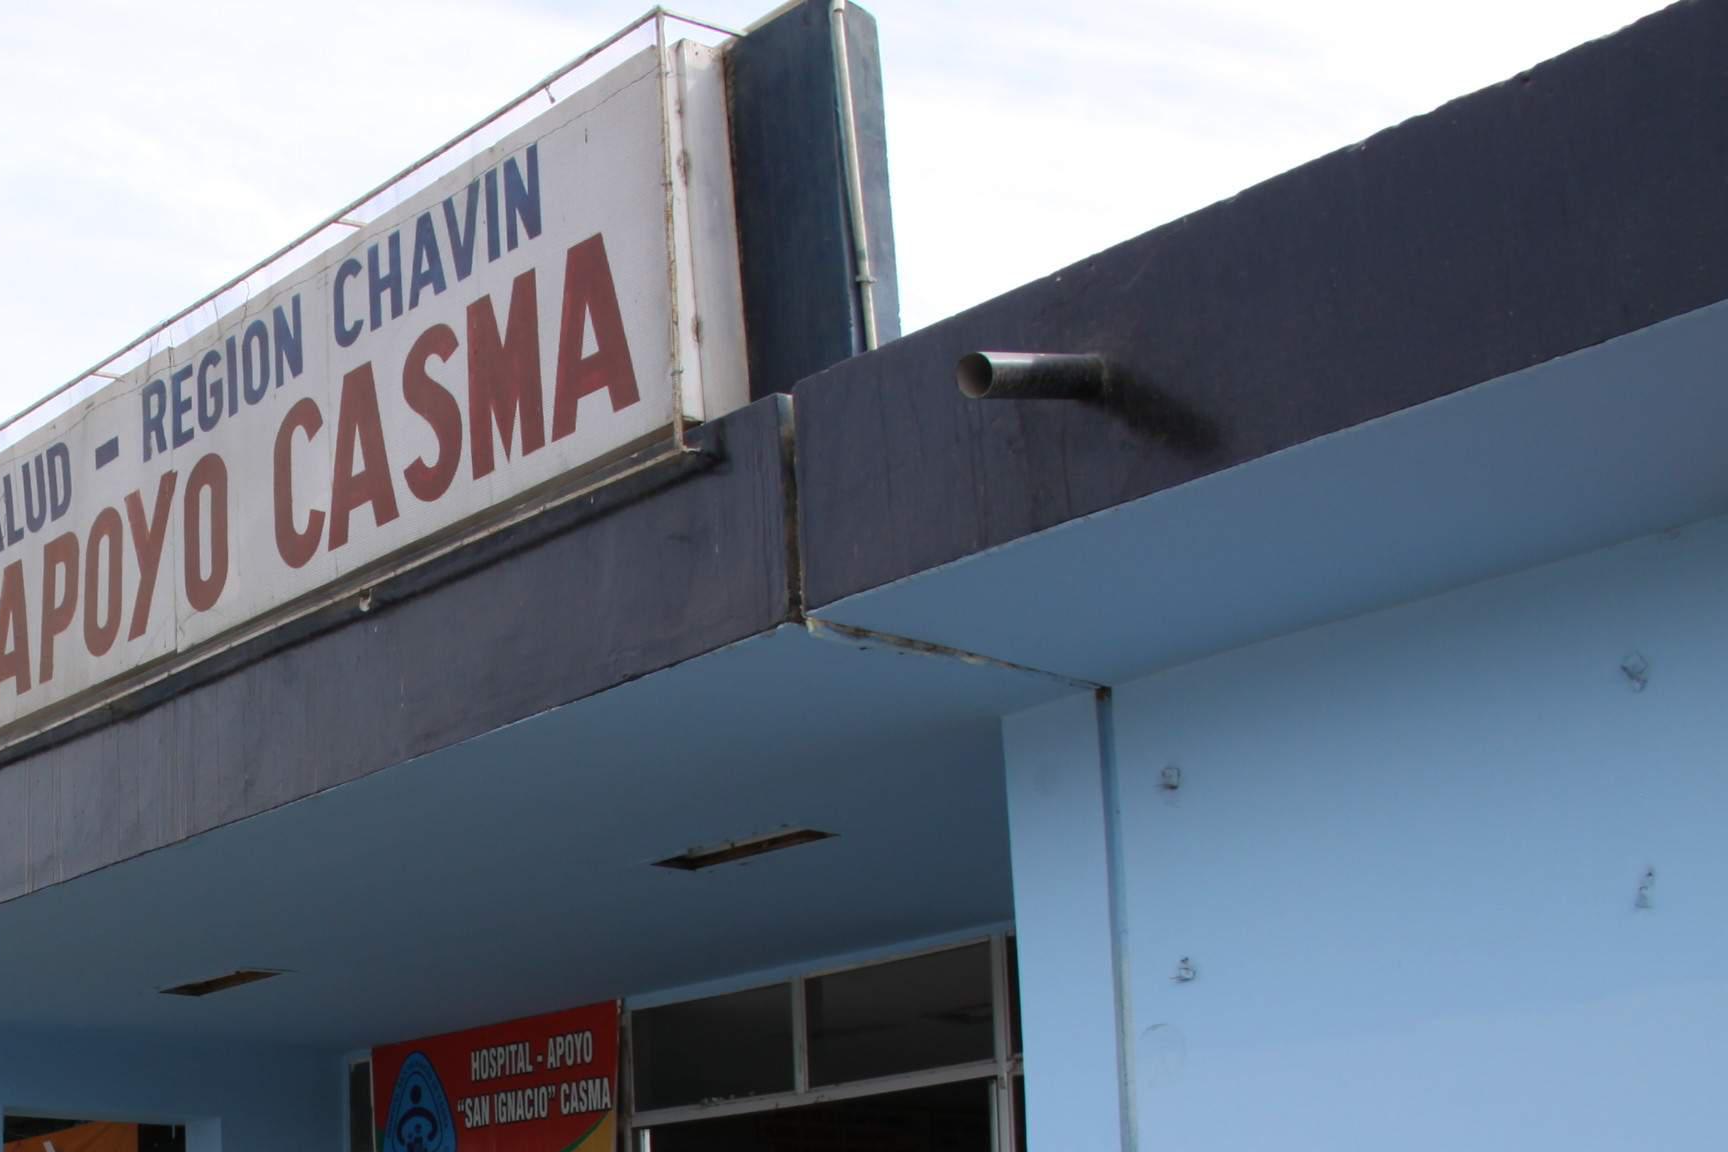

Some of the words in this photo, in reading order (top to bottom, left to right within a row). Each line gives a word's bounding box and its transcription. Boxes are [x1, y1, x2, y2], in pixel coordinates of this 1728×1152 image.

[142, 295, 304, 463] REGION
[333, 145, 543, 347] CHAVIN
[272, 232, 640, 569] CASMA
[471, 1041, 533, 1081] HOSPITAL
[547, 1030, 593, 1069] APOYO
[560, 1077, 612, 1115] CASMA
